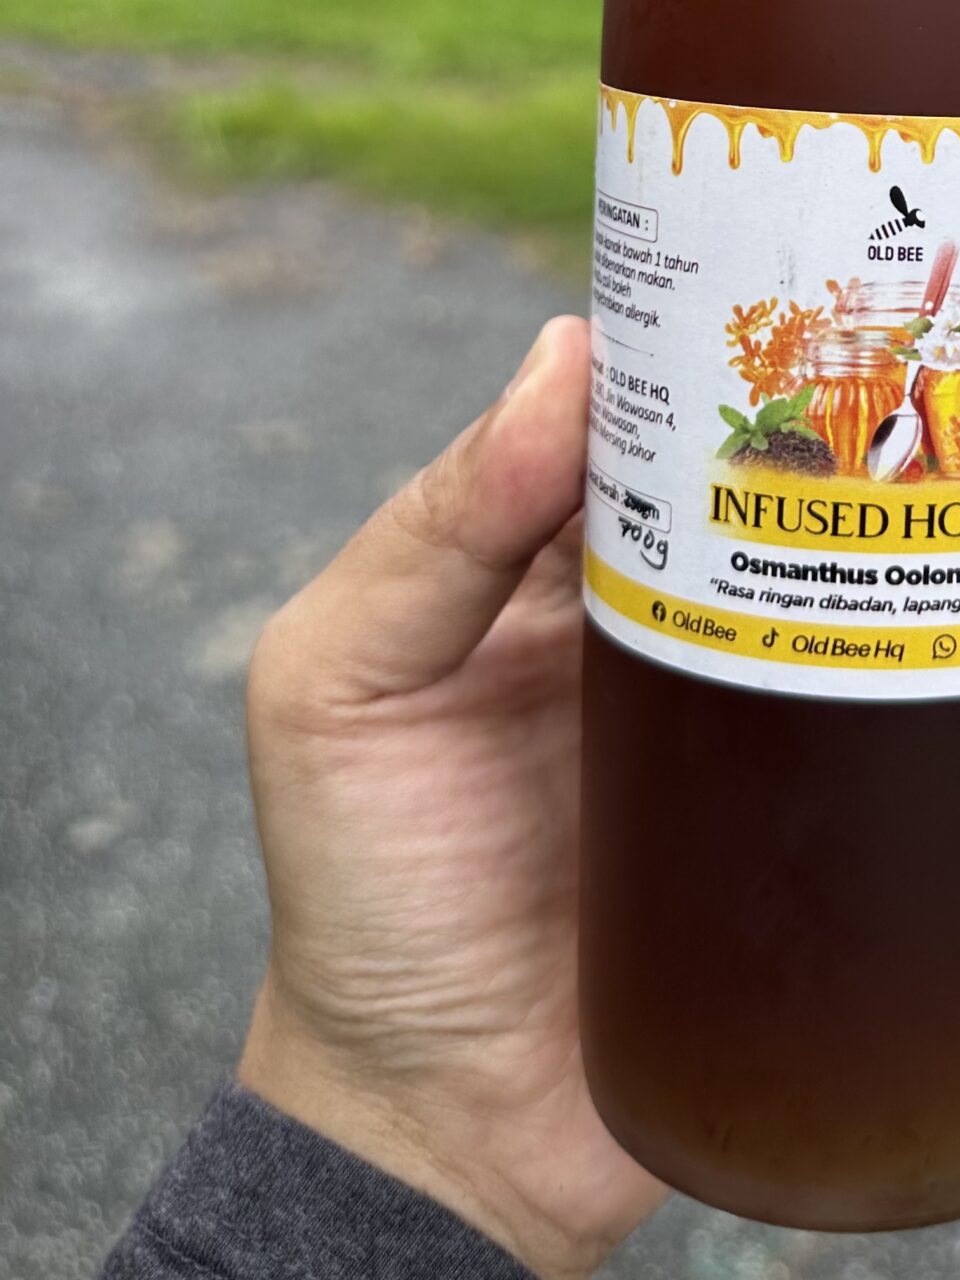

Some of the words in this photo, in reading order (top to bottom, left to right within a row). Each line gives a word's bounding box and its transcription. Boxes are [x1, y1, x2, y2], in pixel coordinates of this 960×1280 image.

[622, 241, 653, 264] bawah
[654, 252, 661, 267] 1
[664, 254, 699, 274] tahun
[868, 245, 894, 261] OLD
[897, 246, 924, 262] BEE
[611, 279, 632, 298] boleh
[636, 269, 675, 291] makan.
[625, 303, 661, 328] allergik.
[609, 366, 626, 388] OLD
[628, 375, 647, 396] BEE
[650, 383, 670, 406] HQ
[602, 403, 640, 440] Wawasan,
[616, 394, 663, 424] Wawasan
[665, 412, 676, 431] 4,
[600, 422, 627, 455] Mersing
[628, 440, 656, 462] Johor
[711, 485, 889, 539] INFUSED
[618, 516, 668, 570] 700g
[730, 551, 878, 585] Osmanthus
[709, 577, 755, 601] “Rasa
[758, 587, 815, 609] ringan
[819, 593, 897, 615] dibadan,
[874, 640, 905, 662] Hq
